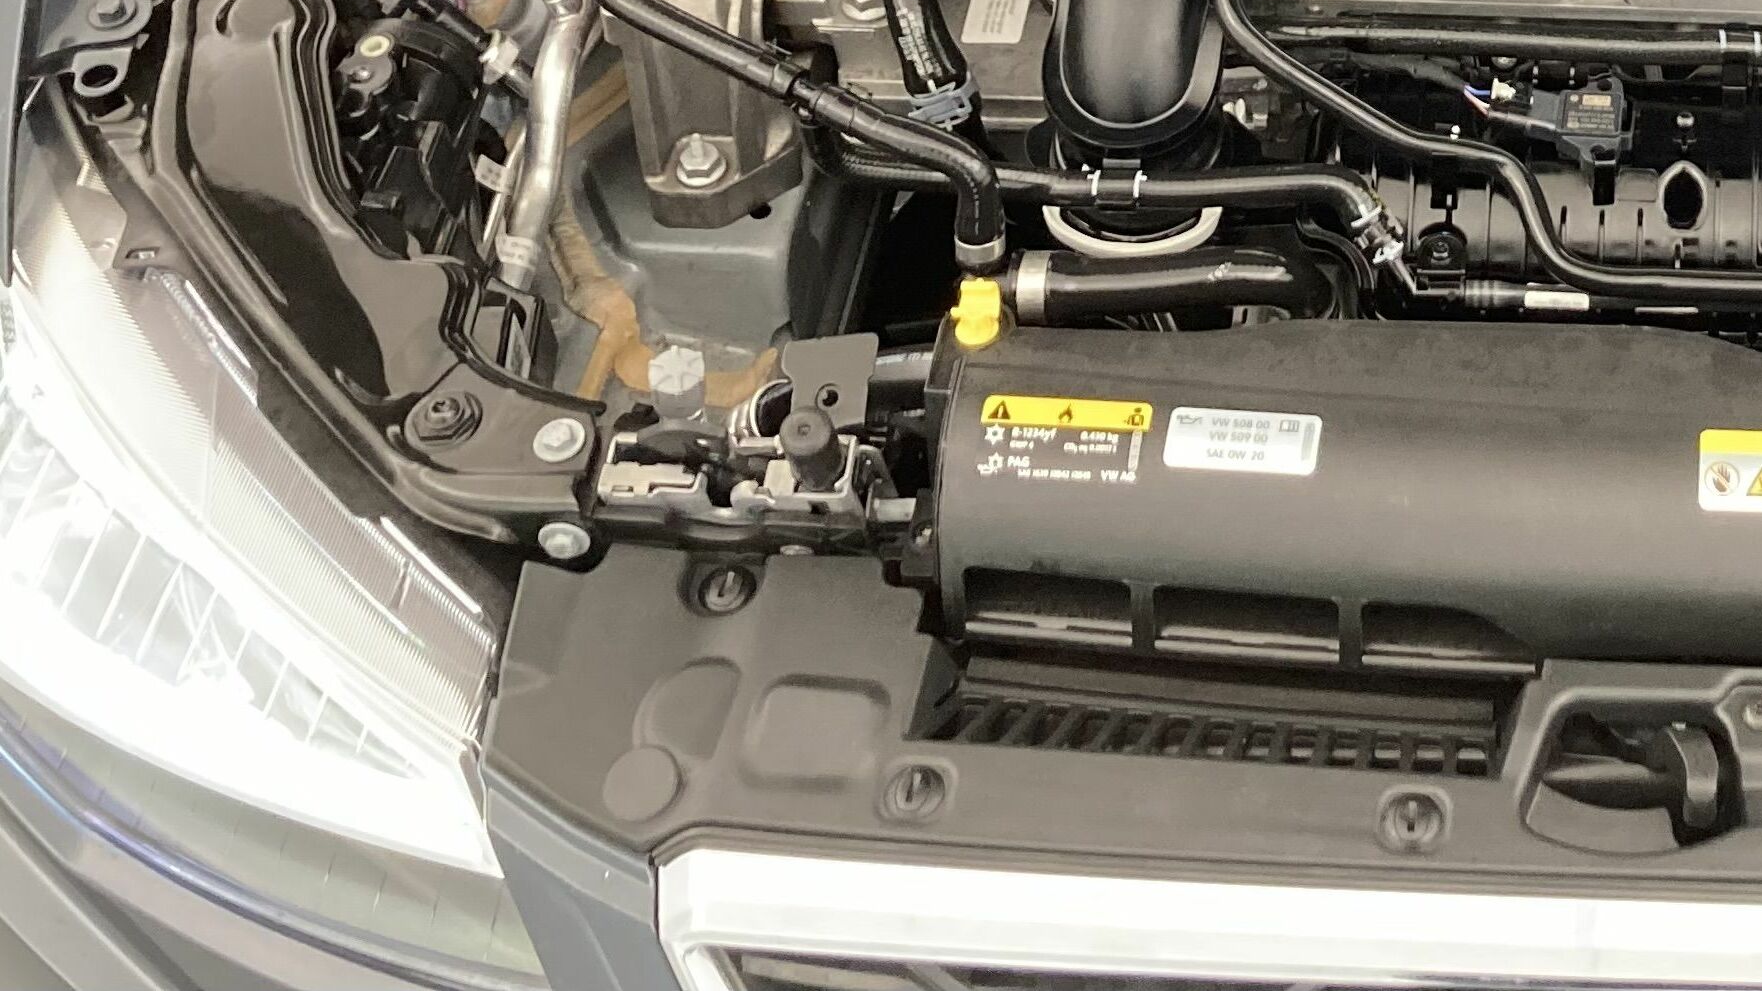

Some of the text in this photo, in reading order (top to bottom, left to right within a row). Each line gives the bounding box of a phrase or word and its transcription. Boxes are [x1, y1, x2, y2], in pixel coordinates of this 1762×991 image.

[1211, 416, 1271, 429] VW 508 00
[1208, 430, 1229, 442] VW
[1254, 433, 1269, 443] 00
[1007, 455, 1031, 468] PAG
[1101, 470, 1137, 482] VW AG
